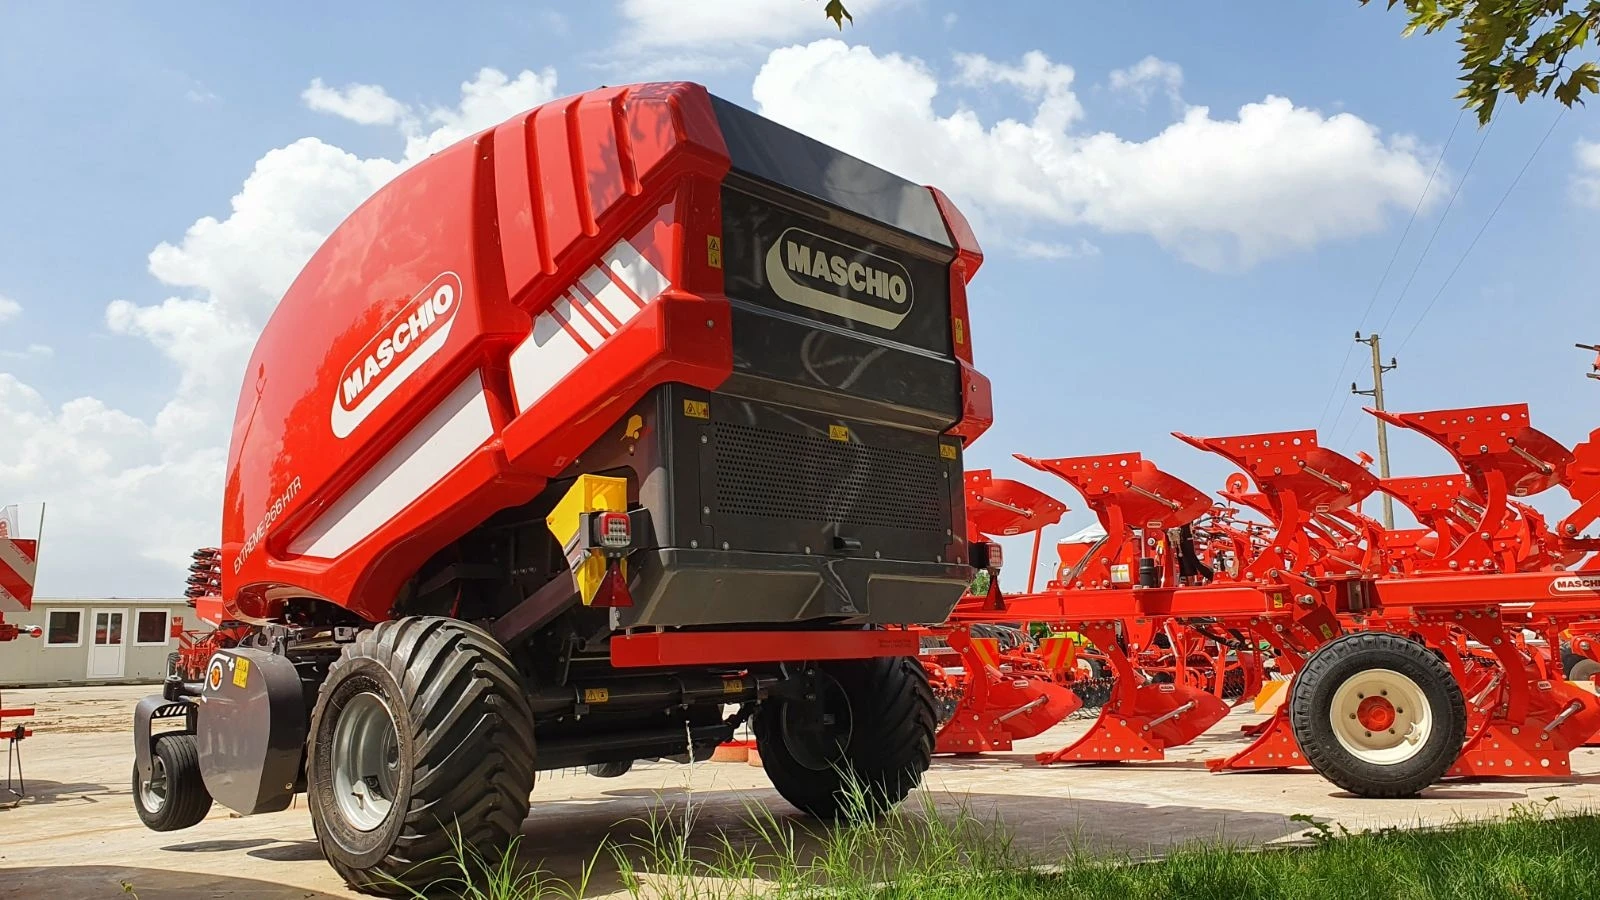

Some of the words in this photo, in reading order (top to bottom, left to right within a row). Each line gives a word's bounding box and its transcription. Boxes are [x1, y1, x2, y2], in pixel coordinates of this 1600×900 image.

[787, 240, 907, 304] MASCHIO
[343, 283, 454, 405] MASCHIO
[233, 520, 265, 575] EXTREME
[264, 498, 282, 529] 266
[282, 476, 301, 507] HTR
